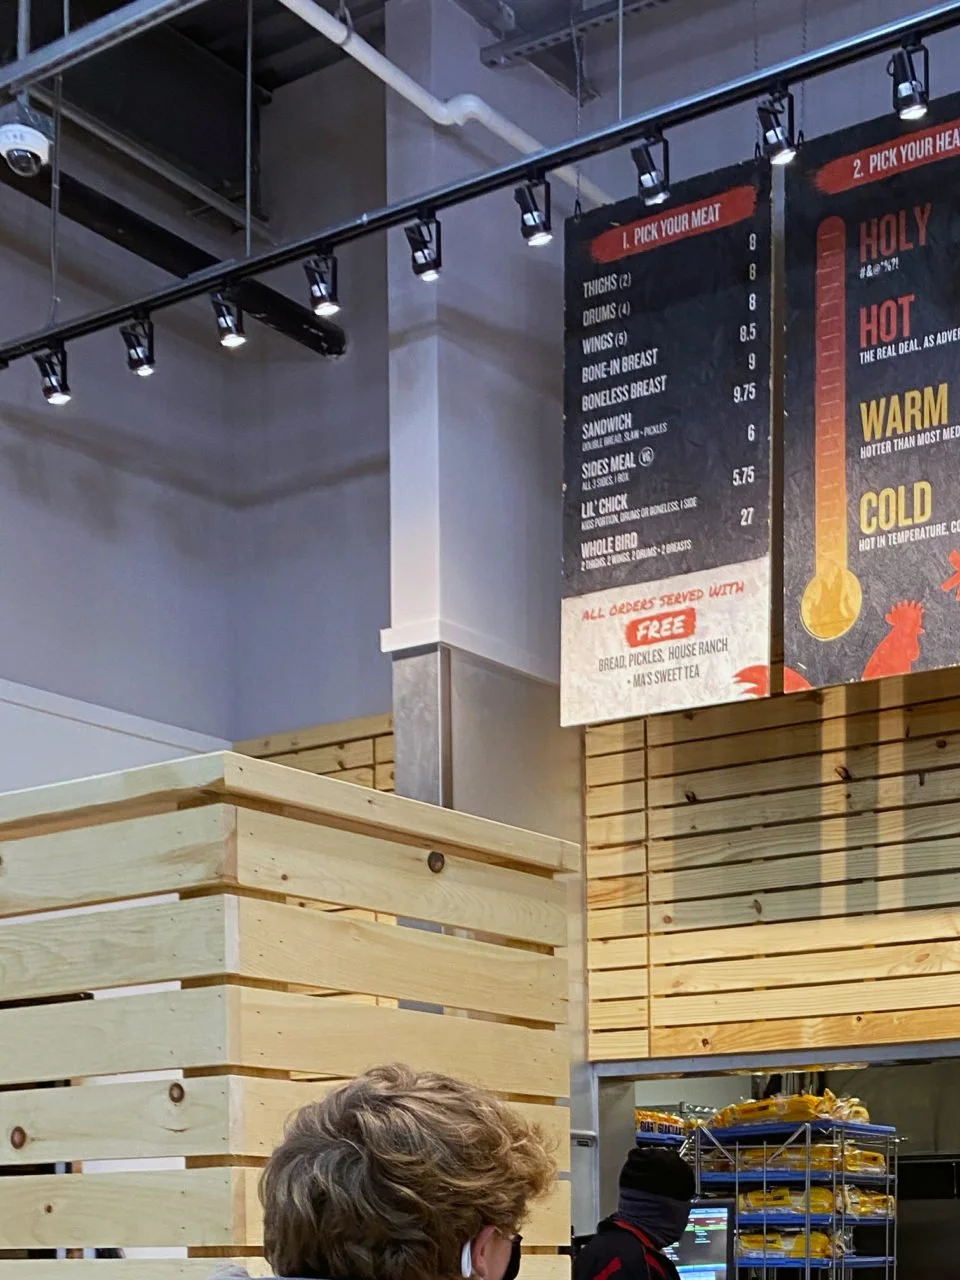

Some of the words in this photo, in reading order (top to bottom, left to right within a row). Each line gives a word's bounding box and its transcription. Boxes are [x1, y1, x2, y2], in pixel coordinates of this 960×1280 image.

[853, 158, 863, 179] 2.
[870, 148, 897, 173] PICK
[900, 136, 933, 164] YOUR
[634, 222, 658, 245] PICK
[661, 213, 689, 237] YOUR
[691, 203, 720, 228] MEAT
[860, 202, 932, 263] HOLY
[583, 274, 617, 298] THIGHS
[619, 272, 631, 289] (2)
[749, 233, 756, 251] 8
[583, 303, 616, 327] DRUMS
[618, 301, 630, 318] (4)
[749, 263, 756, 281] 8
[860, 293, 915, 349] HOT
[582, 332, 613, 355] WINGS
[749, 293, 756, 311] 8
[860, 349, 875, 364] THE
[877, 344, 896, 360] REAL
[923, 335, 934, 348] AS
[582, 359, 620, 383] BONE-IN
[622, 349, 658, 372] BREAST
[740, 323, 756, 342] 8.5
[582, 385, 628, 411] BONELESS
[631, 375, 666, 399] BREAST
[748, 353, 755, 370] 9
[582, 413, 631, 440] SANDWICH
[733, 382, 756, 403] 9.75
[860, 382, 948, 443] WARM
[582, 458, 609, 479] SIDES
[611, 452, 636, 472] MEAL
[748, 424, 755, 441] 6
[860, 441, 891, 459] HOTTER
[893, 435, 915, 451] THAN
[917, 430, 940, 446] MOST
[582, 500, 597, 519] LIL'
[599, 493, 628, 515] CHICK
[733, 466, 754, 486] 5.75
[860, 479, 932, 536] COLD
[581, 538, 614, 559] WHOLE
[616, 532, 637, 551] BIRD
[741, 508, 754, 526] 27
[859, 537, 875, 552] HOT
[877, 535, 886, 548] IN
[583, 607, 605, 621] ALL
[610, 598, 656, 616] ORDERS
[659, 589, 703, 607] SERVED
[709, 581, 744, 598] WITH
[599, 655, 627, 673] BREAD,
[629, 649, 665, 668] PICKLES,
[668, 643, 696, 660] HOUSE
[699, 638, 728, 655] RANCH
[636, 616, 685, 642] FREE
[633, 673, 652, 687] MA'S
[654, 667, 682, 684] SWEET
[684, 664, 700, 678] TEA
